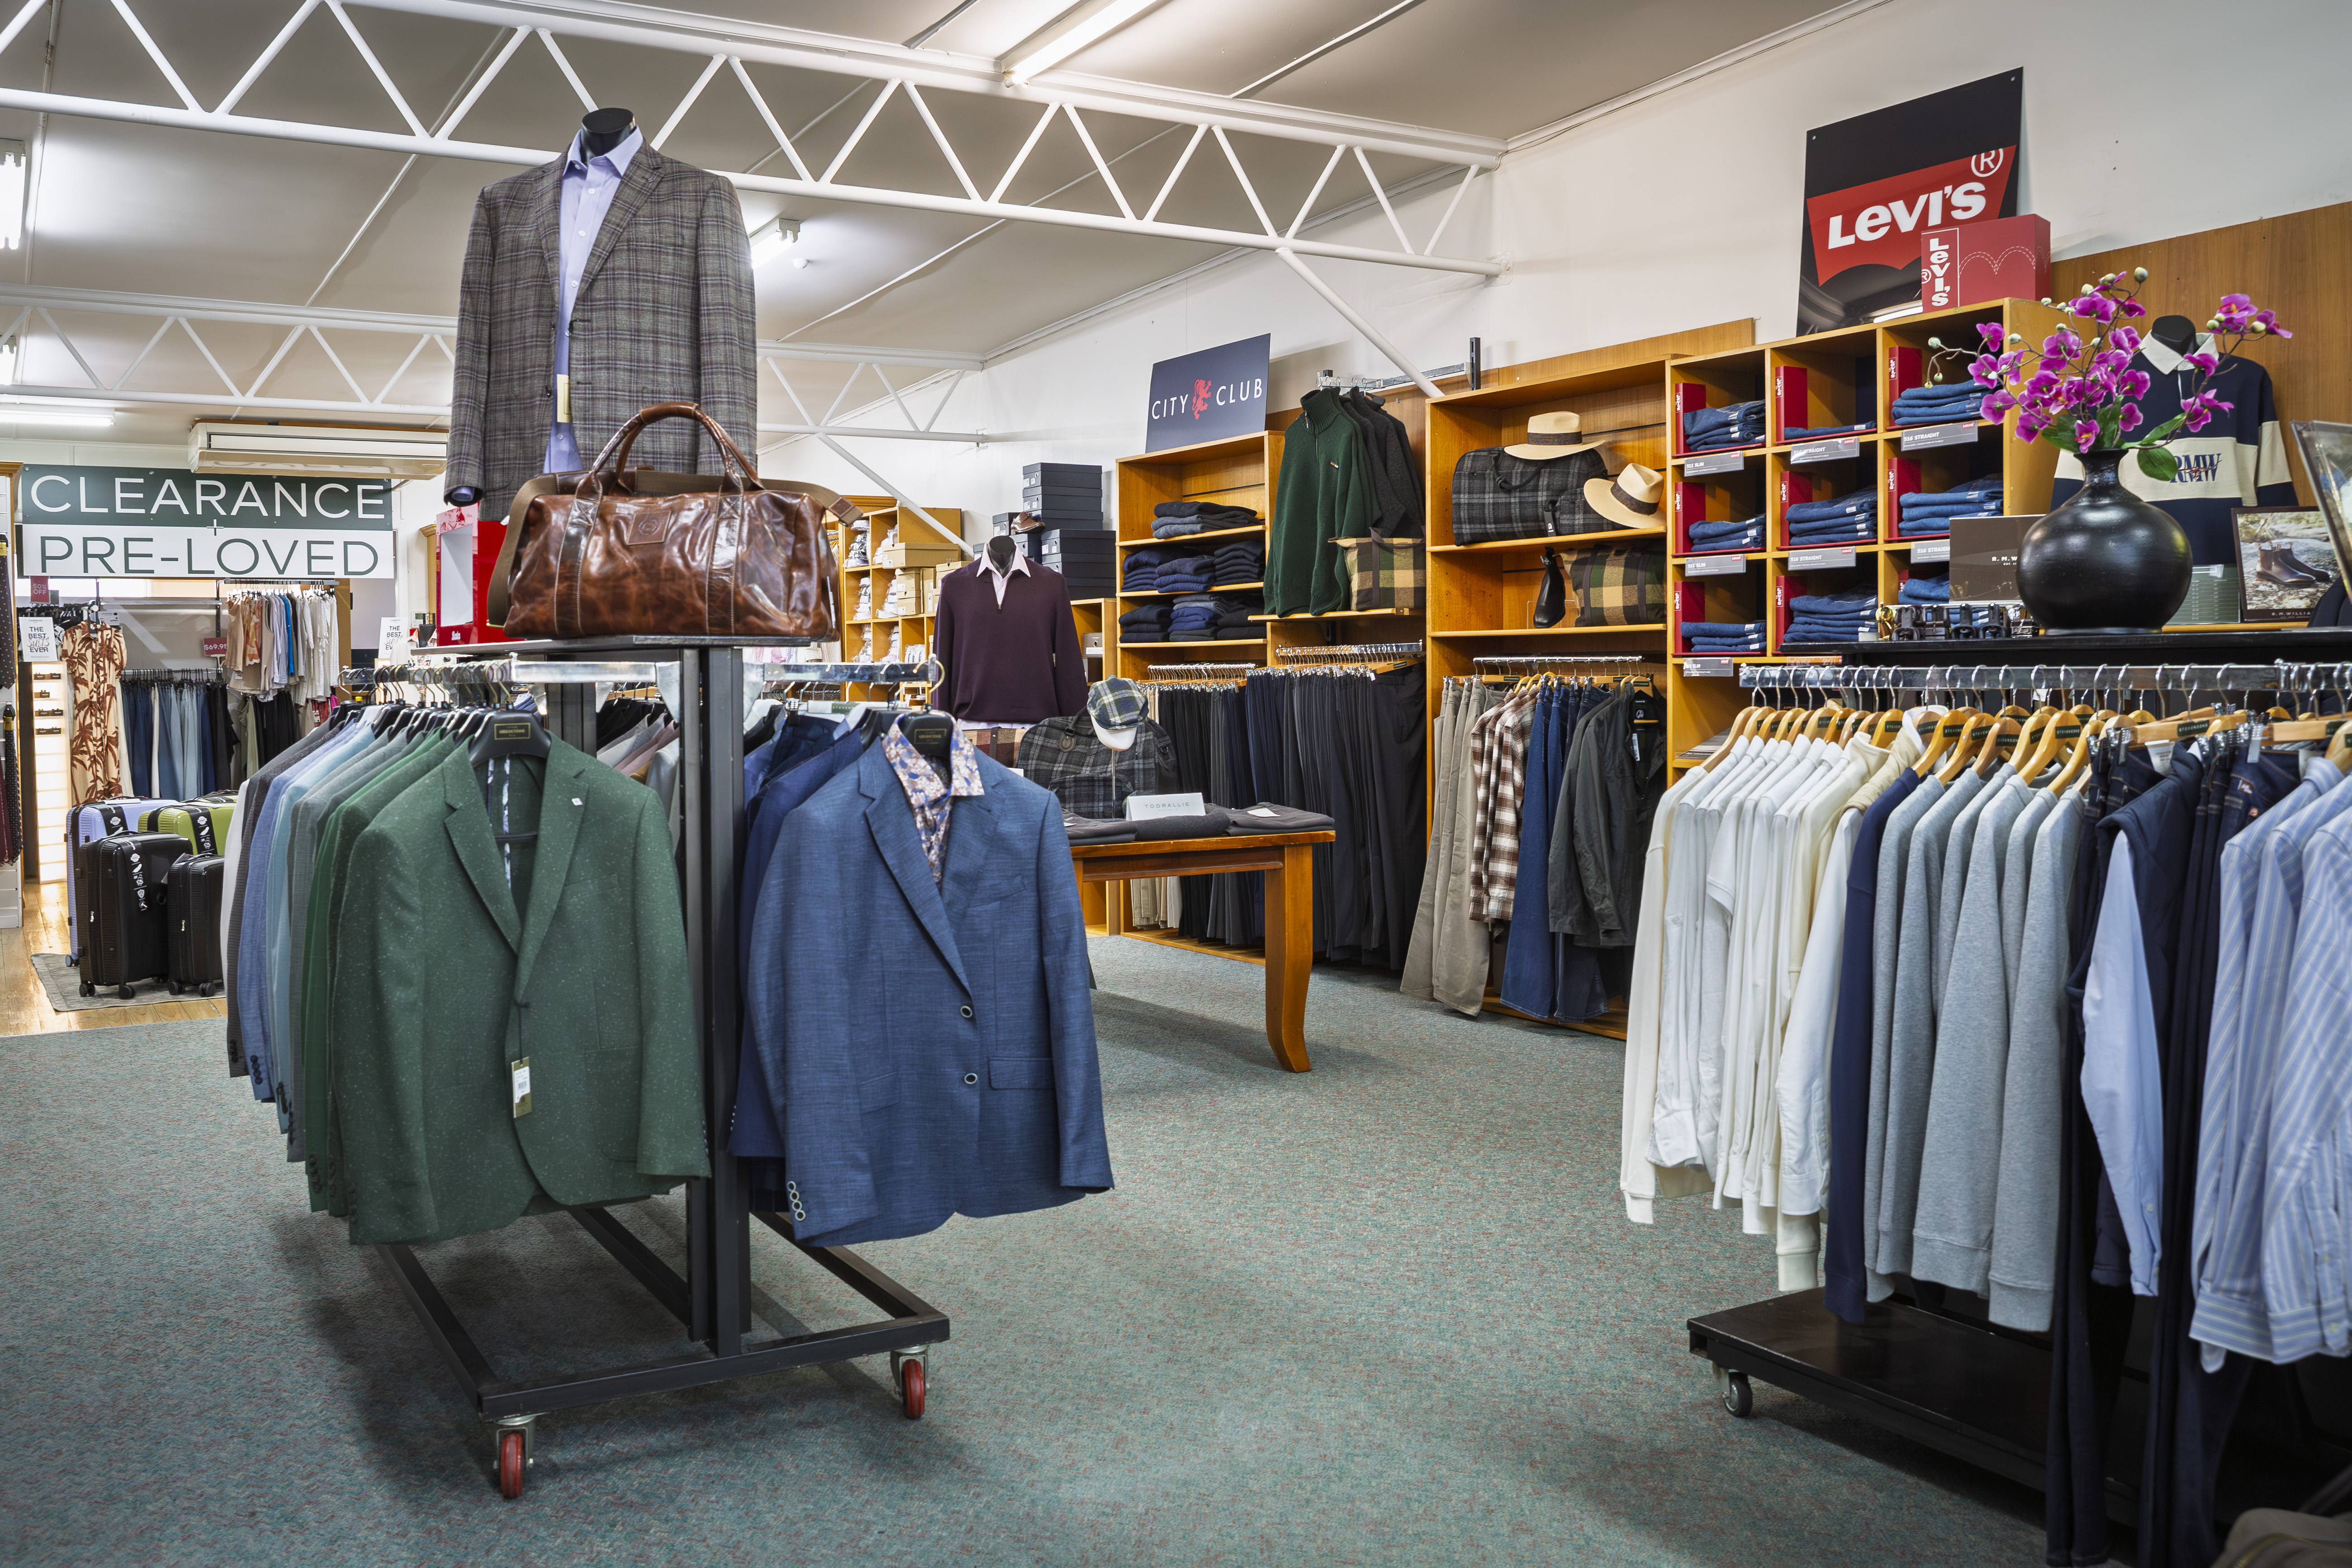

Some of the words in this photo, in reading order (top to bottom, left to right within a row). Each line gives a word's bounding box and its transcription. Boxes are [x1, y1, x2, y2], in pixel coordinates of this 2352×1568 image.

[1152, 394, 1189, 419] CITY
[1216, 378, 1262, 406] CLUB
[1914, 432, 1940, 441] STRAIGHT
[31, 475, 384, 519] CLEARANCE
[40, 535, 378, 576] PRE-LOVED
[2179, 723, 2208, 732] STEVENSONS
